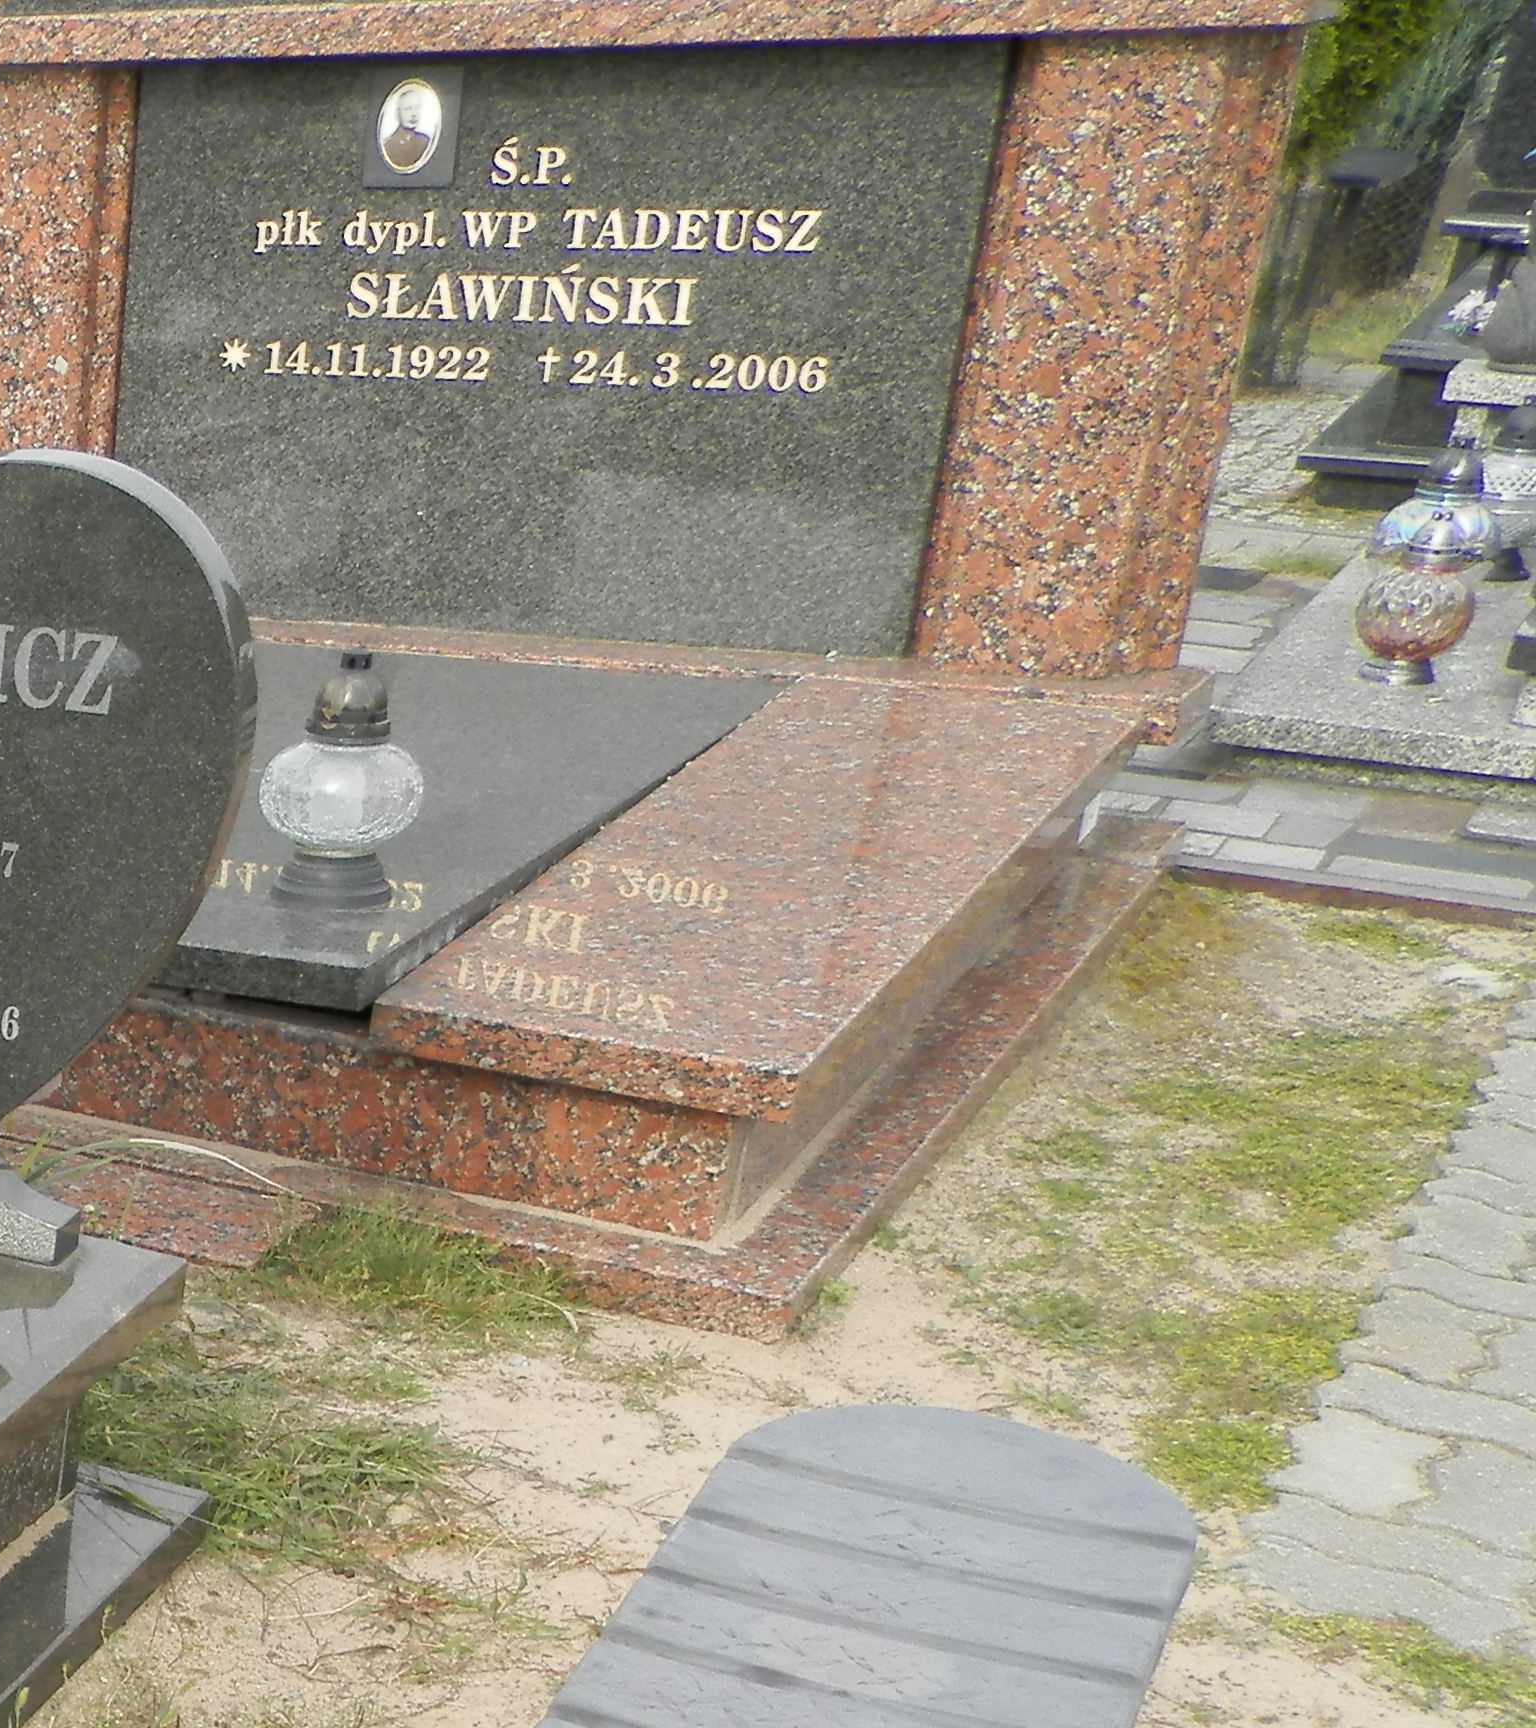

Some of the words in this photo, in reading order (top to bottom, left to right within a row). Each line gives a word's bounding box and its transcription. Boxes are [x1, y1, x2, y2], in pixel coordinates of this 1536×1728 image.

[491, 136, 573, 187] Ś.P.
[253, 209, 322, 255] płk
[343, 210, 446, 256] dypl.
[463, 210, 538, 248] WP
[563, 208, 824, 254] TADEUSZ
[347, 263, 698, 327] SŁAWIŃSKI
[263, 341, 491, 383] 14.11.1922
